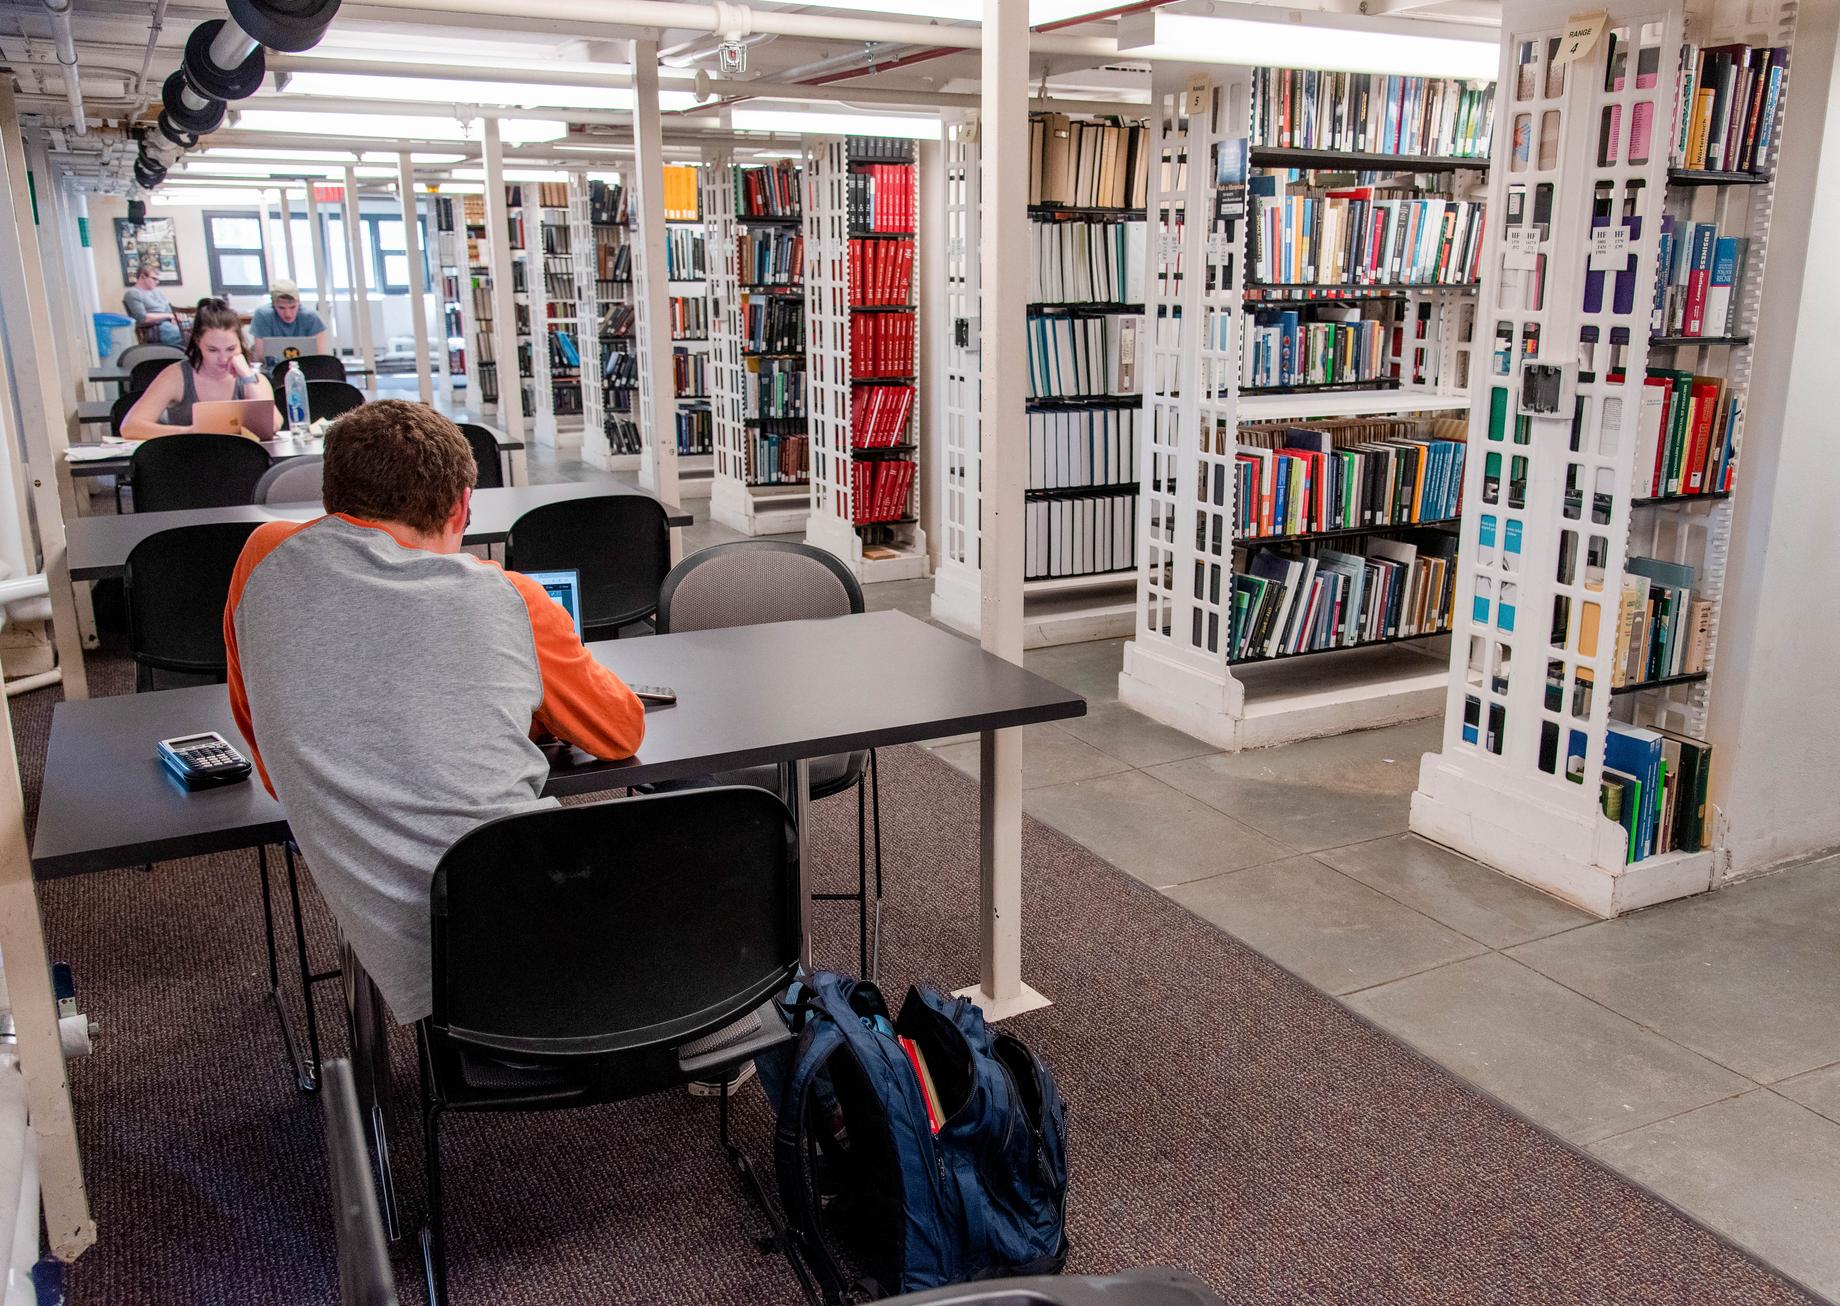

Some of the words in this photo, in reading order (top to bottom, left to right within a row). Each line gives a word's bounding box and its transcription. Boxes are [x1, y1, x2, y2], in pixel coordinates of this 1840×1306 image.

[1568, 28, 1592, 38] RANGE
[1570, 42, 1579, 54] 4
[1194, 96, 1200, 106] 5
[1615, 230, 1624, 238] HF
[1699, 231, 1711, 270] BUSINESS
[1695, 271, 1705, 302] dictionary
